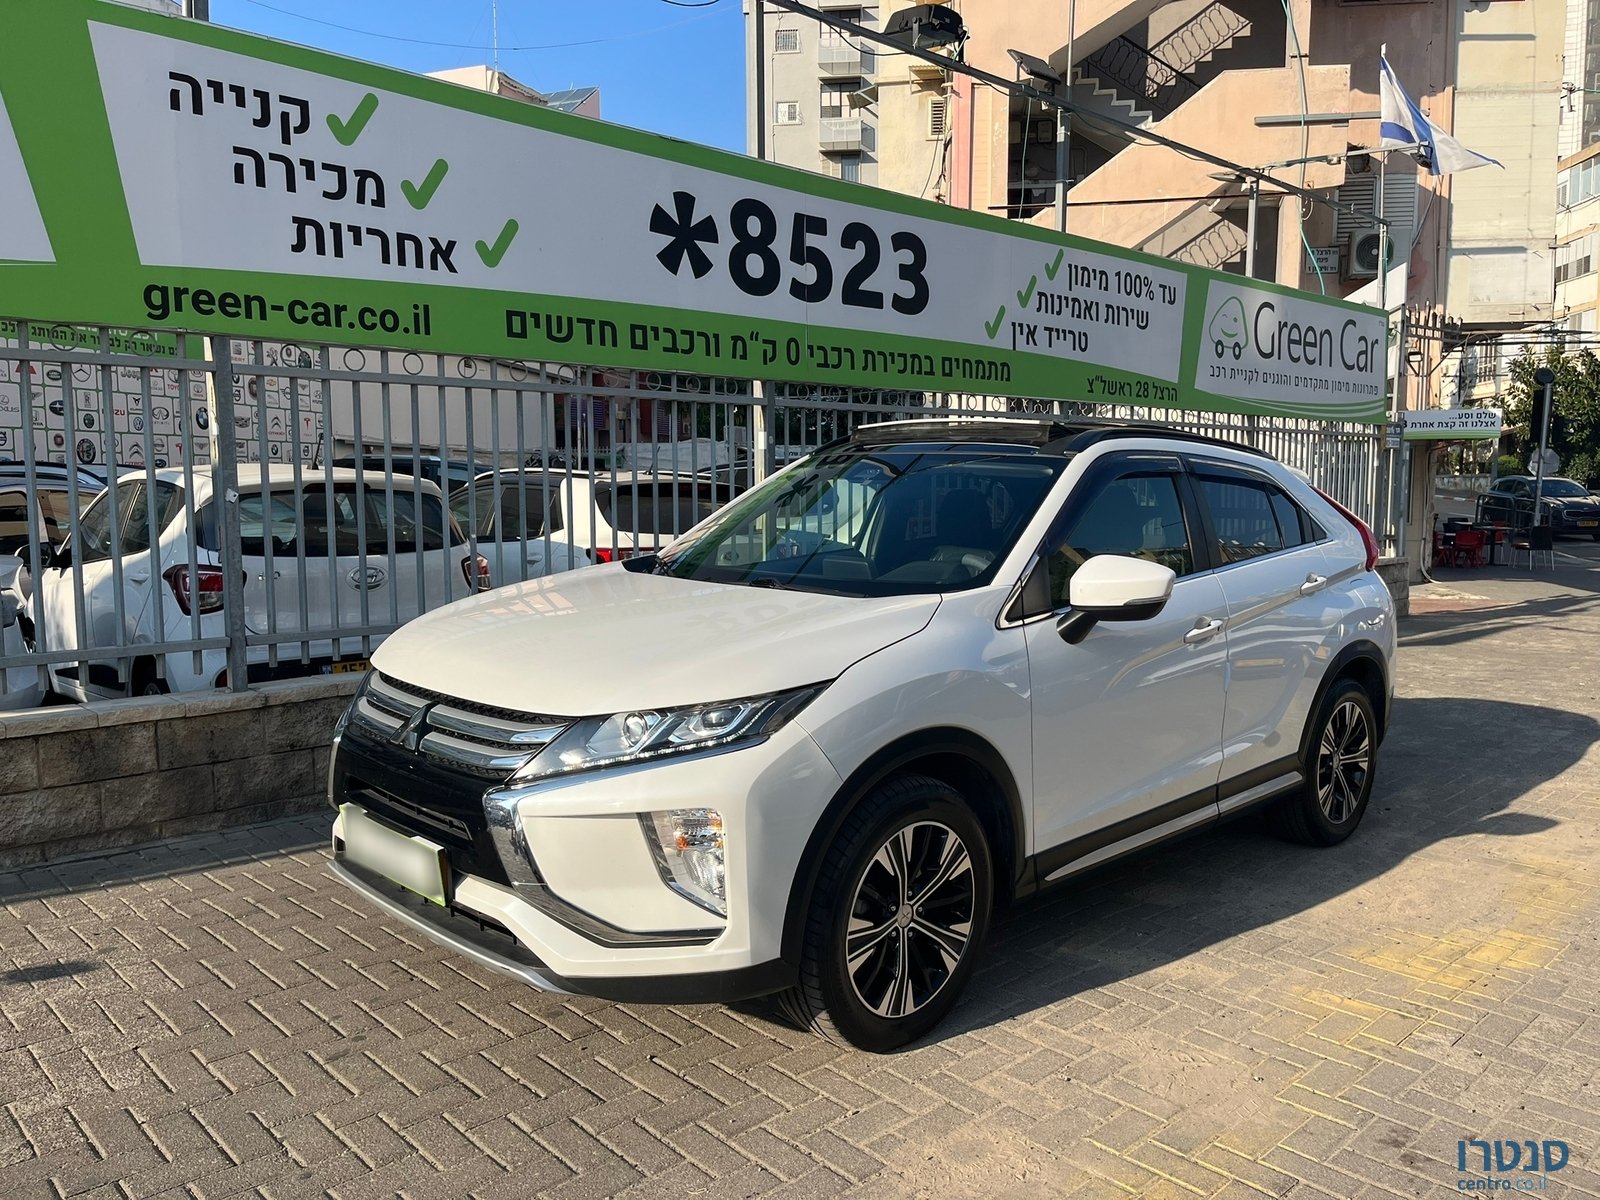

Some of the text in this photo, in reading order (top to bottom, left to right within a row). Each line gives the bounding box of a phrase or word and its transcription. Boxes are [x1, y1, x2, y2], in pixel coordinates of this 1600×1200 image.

[168, 71, 311, 145] קנייה
[232, 145, 386, 208] מכירה
[290, 215, 458, 273] אחריות
[1068, 263, 1176, 305] עד 100% מימון
[143, 283, 431, 336] green-car.co.il
[1036, 290, 1149, 330] שירות ואמינות
[91, 334, 120, 347] לבור
[505, 309, 618, 348] חדשים
[630, 324, 721, 357] ורכבים
[1011, 321, 1088, 352] טרייד אין
[1254, 301, 1379, 373] Green Car
[786, 337, 800, 366] 0
[807, 343, 855, 371] רכבי
[862, 349, 935, 377] במכירת
[941, 357, 1011, 383] מתמחים
[1209, 364, 1379, 396] פתרונות מימון מתקדמים והוגנים לקניית רכב
[1135, 381, 1149, 398] 28
[1152, 382, 1178, 401] הרצל
[1410, 421, 1435, 429] אחרת
[1436, 421, 1456, 430] קצת
[1458, 420, 1469, 428] זה
[1475, 411, 1497, 419] שלם
